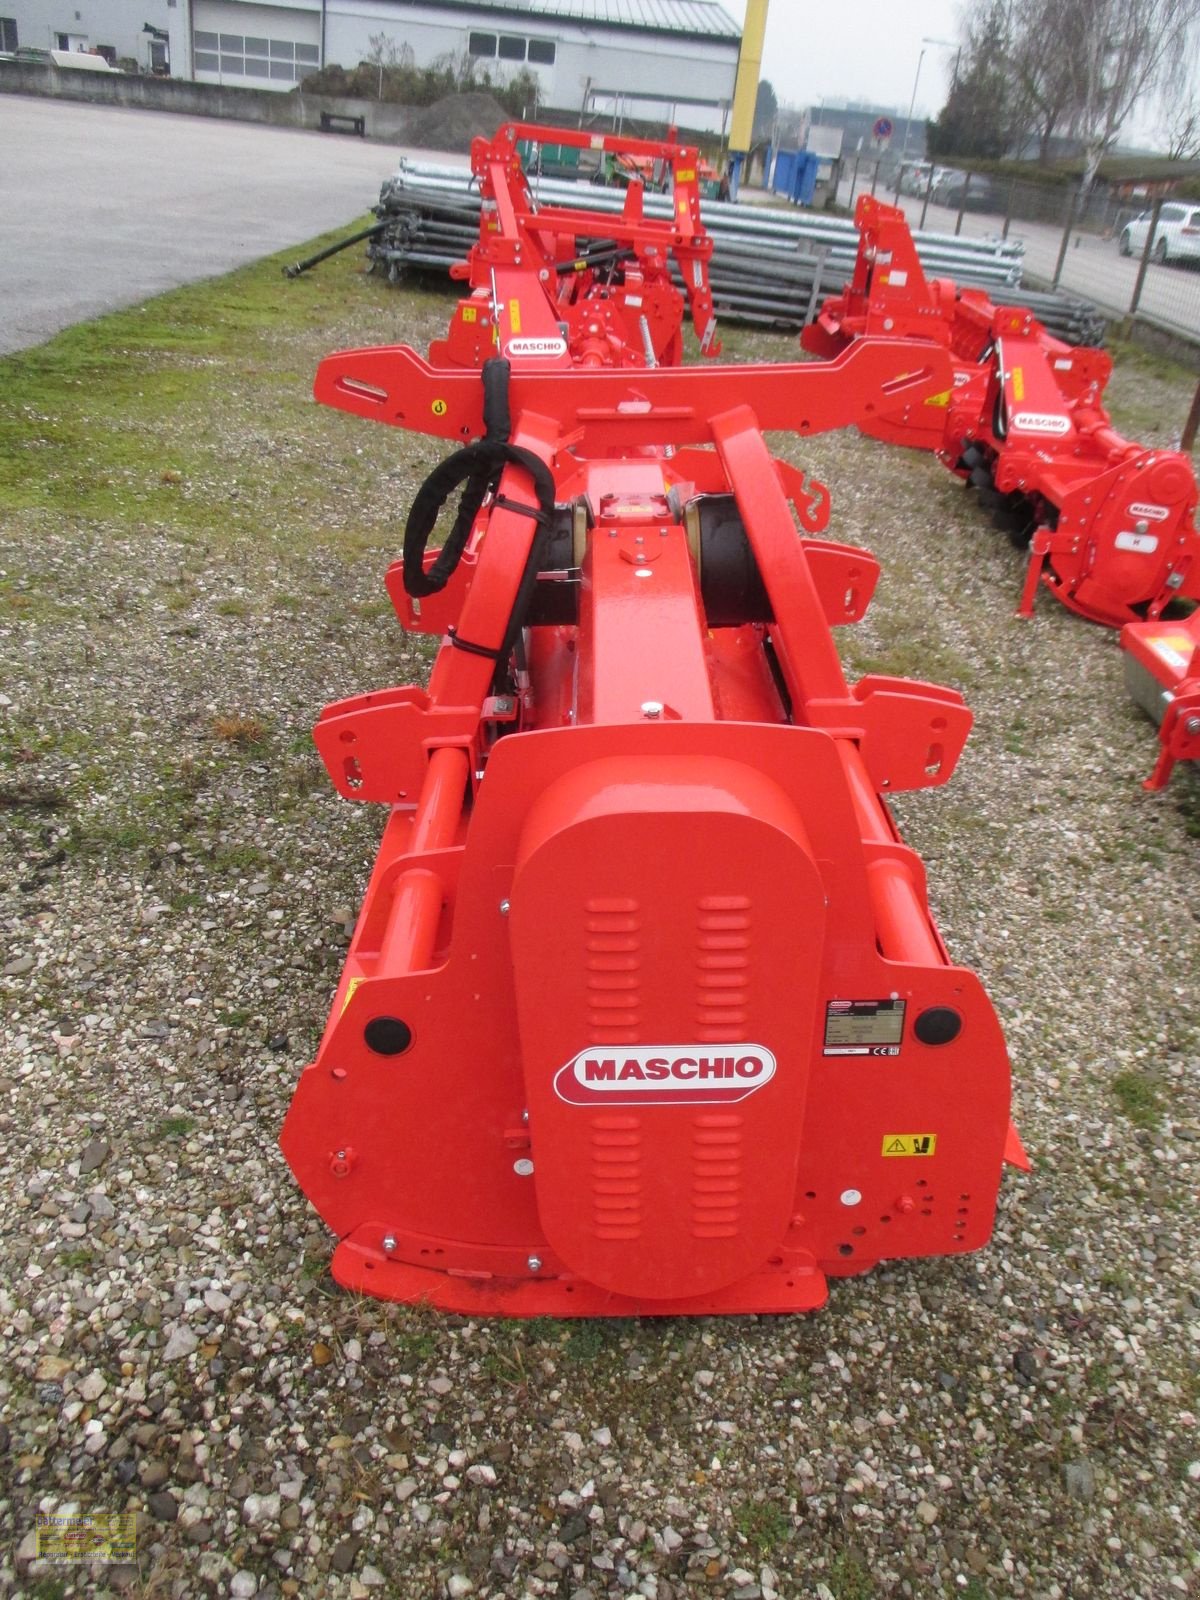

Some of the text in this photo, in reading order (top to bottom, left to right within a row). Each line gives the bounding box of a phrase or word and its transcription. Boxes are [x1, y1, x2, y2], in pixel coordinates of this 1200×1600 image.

[512, 342, 562, 351] MASCHIO
[1018, 417, 1066, 429] MASCHIO
[1132, 505, 1166, 517] MASCHIO
[584, 1055, 764, 1081] MASCHIO
